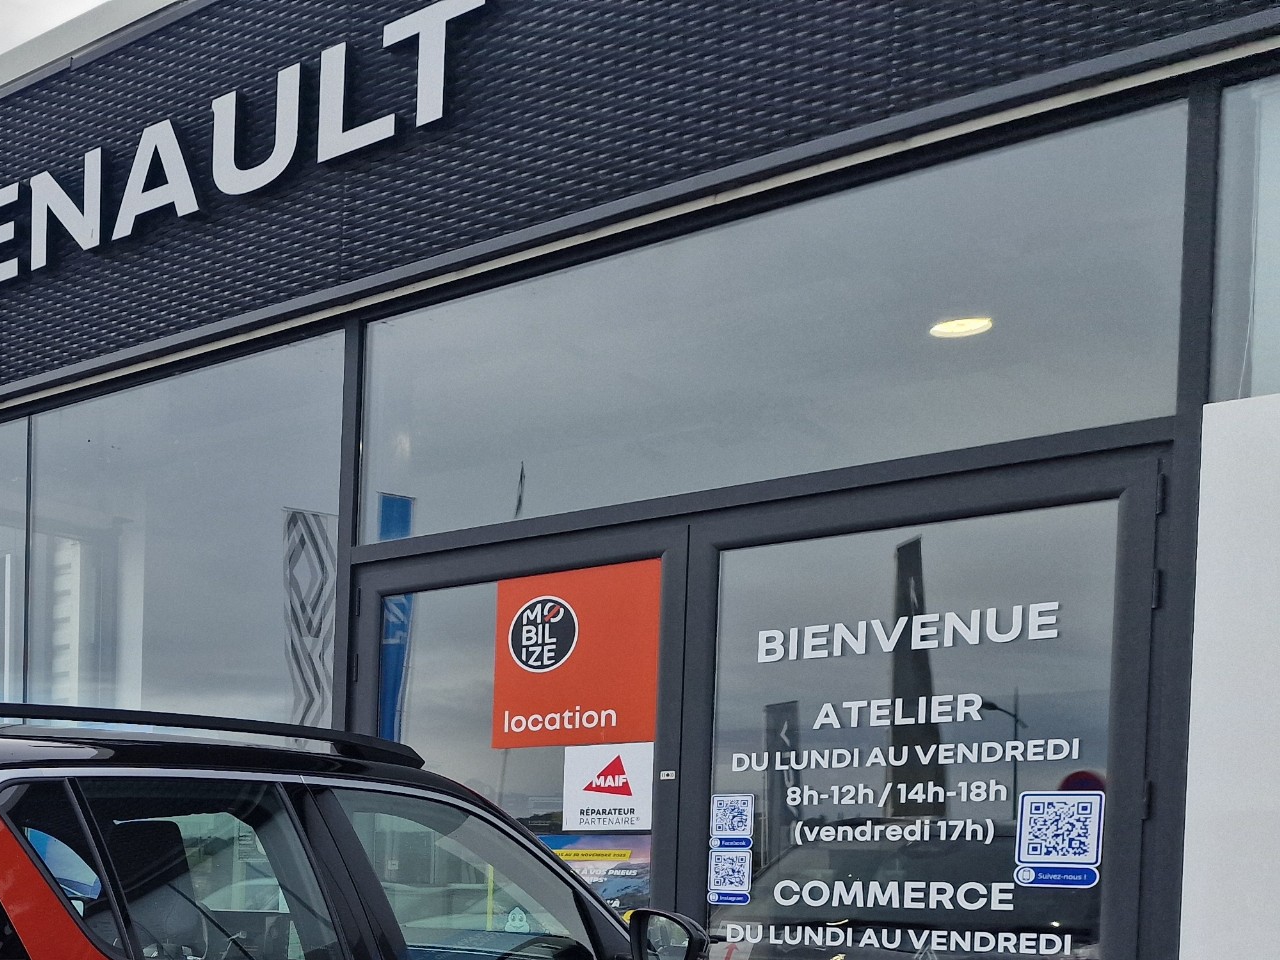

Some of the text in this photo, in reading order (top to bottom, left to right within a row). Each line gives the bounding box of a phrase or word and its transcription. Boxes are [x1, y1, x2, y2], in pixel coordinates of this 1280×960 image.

[756, 601, 1061, 664] BIENVENUE
[503, 705, 617, 733] location
[812, 693, 984, 730] ATELIER
[731, 738, 1081, 773] DU LUNDI AU VENDREDI
[592, 775, 628, 788] MAIF
[785, 784, 875, 807] 8h-12h
[896, 779, 1008, 805] 14h-18h
[579, 806, 635, 816] RÉPARATEUR
[794, 817, 996, 846] (vendredi 17h)
[1037, 872, 1082, 881] Suivez-nous
[773, 879, 1016, 912] COMMERCE
[725, 923, 1073, 956] DU LUNDI AU VENDREDI
